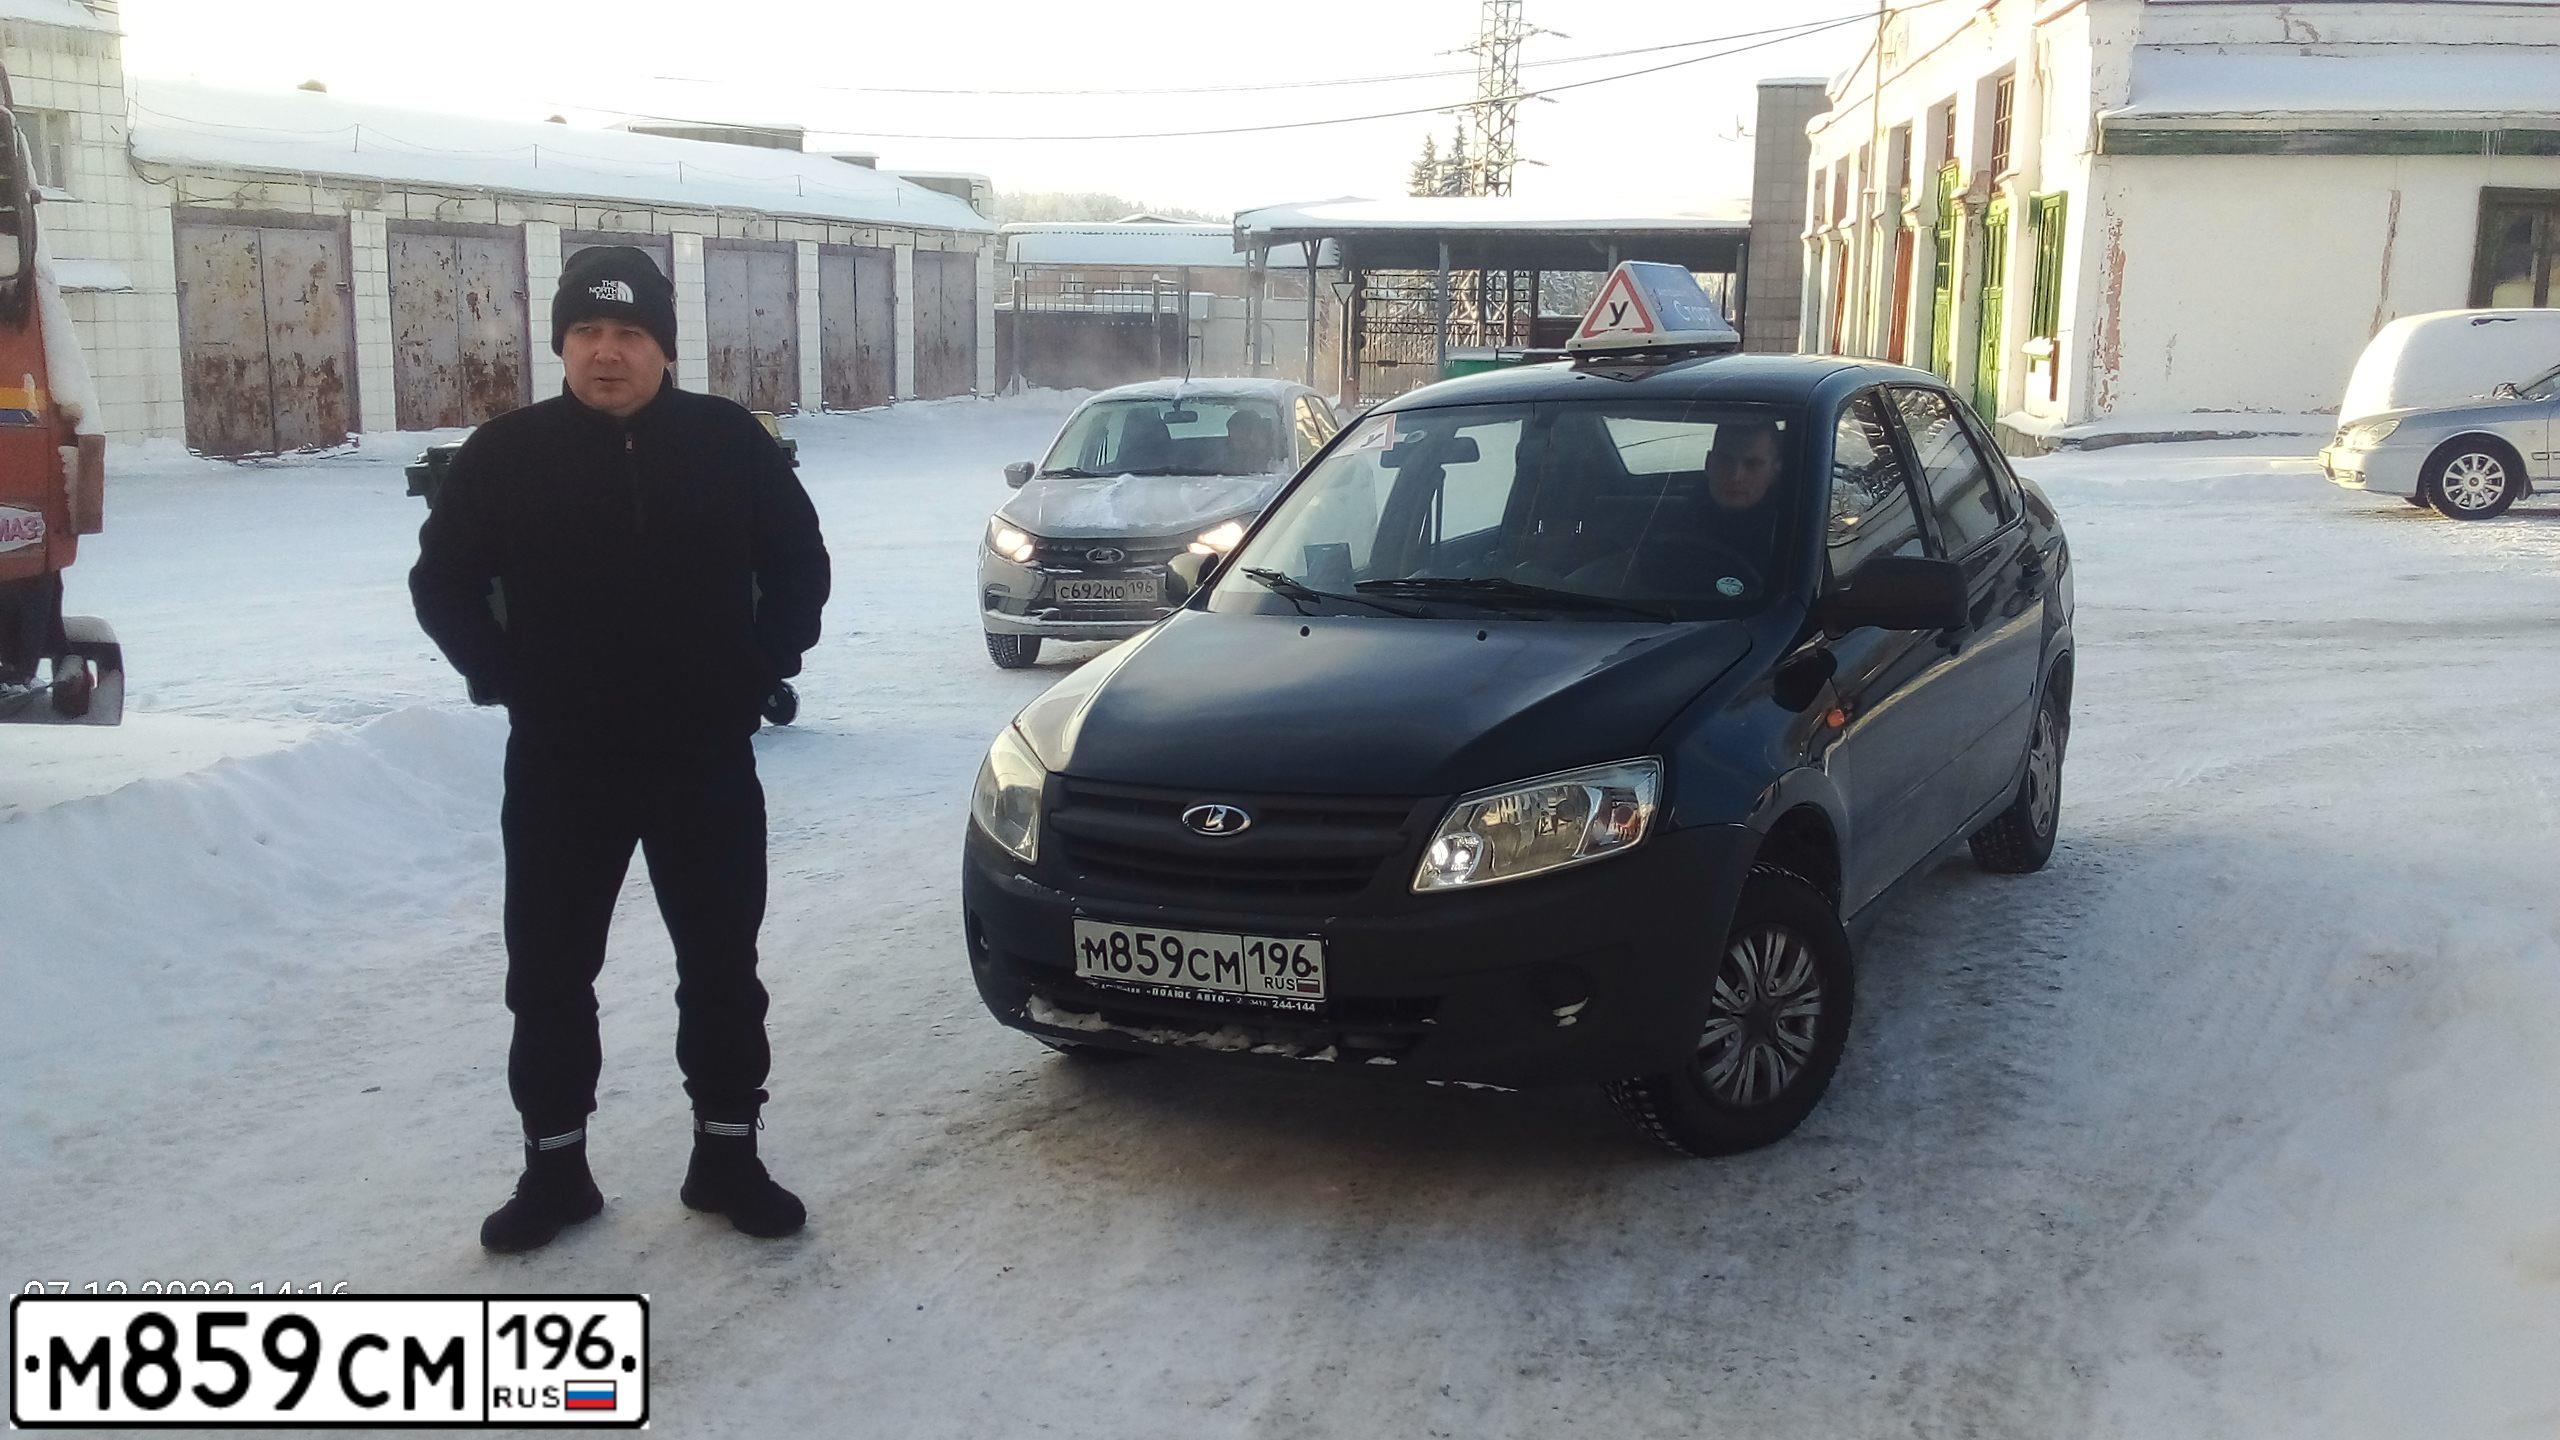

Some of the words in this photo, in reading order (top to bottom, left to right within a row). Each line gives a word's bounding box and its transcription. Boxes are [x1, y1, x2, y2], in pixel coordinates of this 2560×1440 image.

[589, 286, 617, 294] NORTH
[602, 280, 618, 288] THE
[1128, 580, 1153, 594] 196
[1248, 941, 1312, 978] 196
[1264, 976, 1296, 991] RUS
[1272, 1000, 1316, 1012] 244-144
